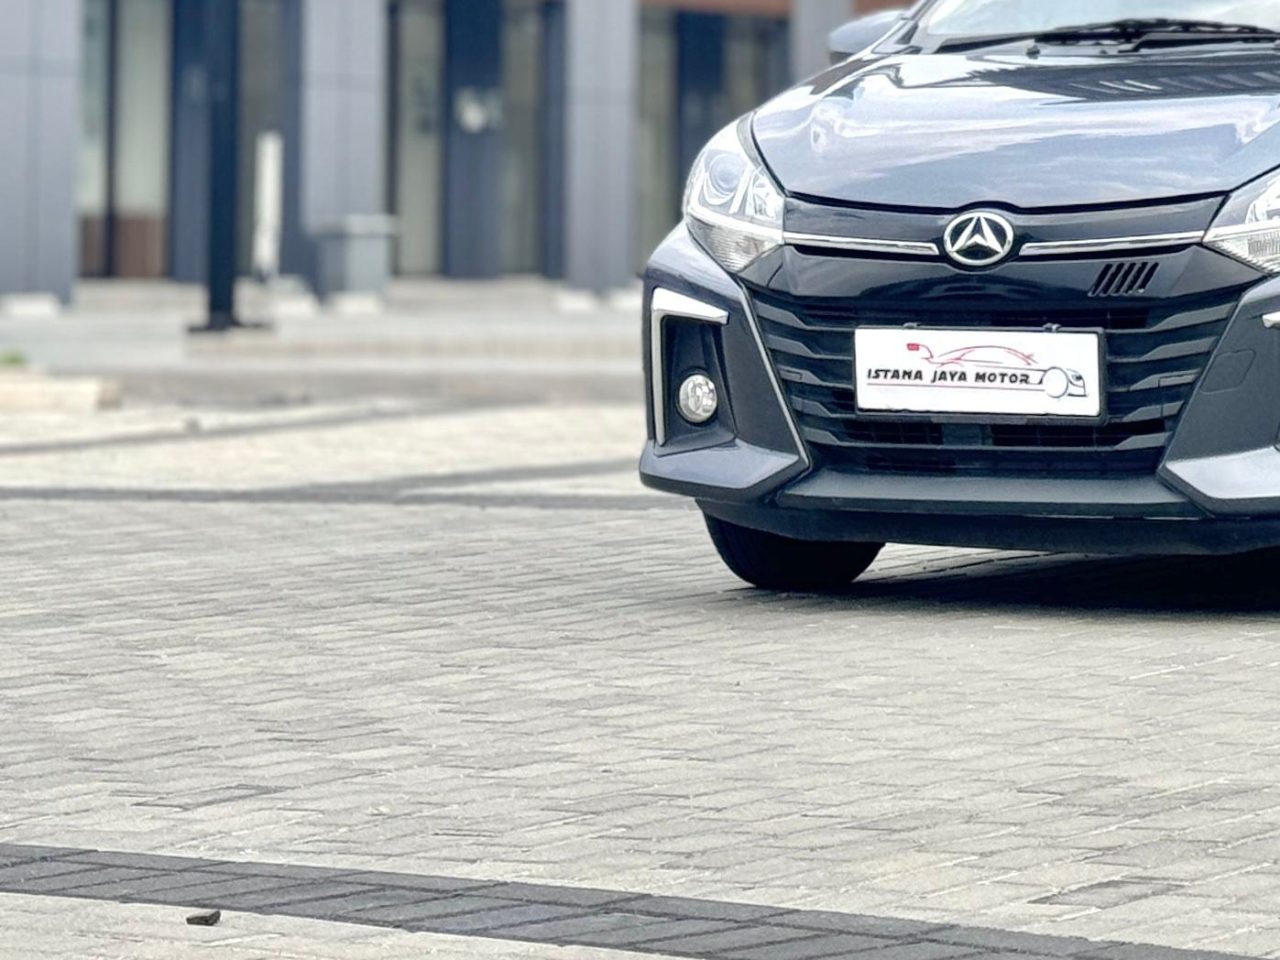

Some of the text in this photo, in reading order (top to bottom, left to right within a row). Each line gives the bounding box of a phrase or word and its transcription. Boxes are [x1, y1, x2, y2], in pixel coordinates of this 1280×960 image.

[867, 369, 1030, 385] ISTANA JAYA MOTOR
